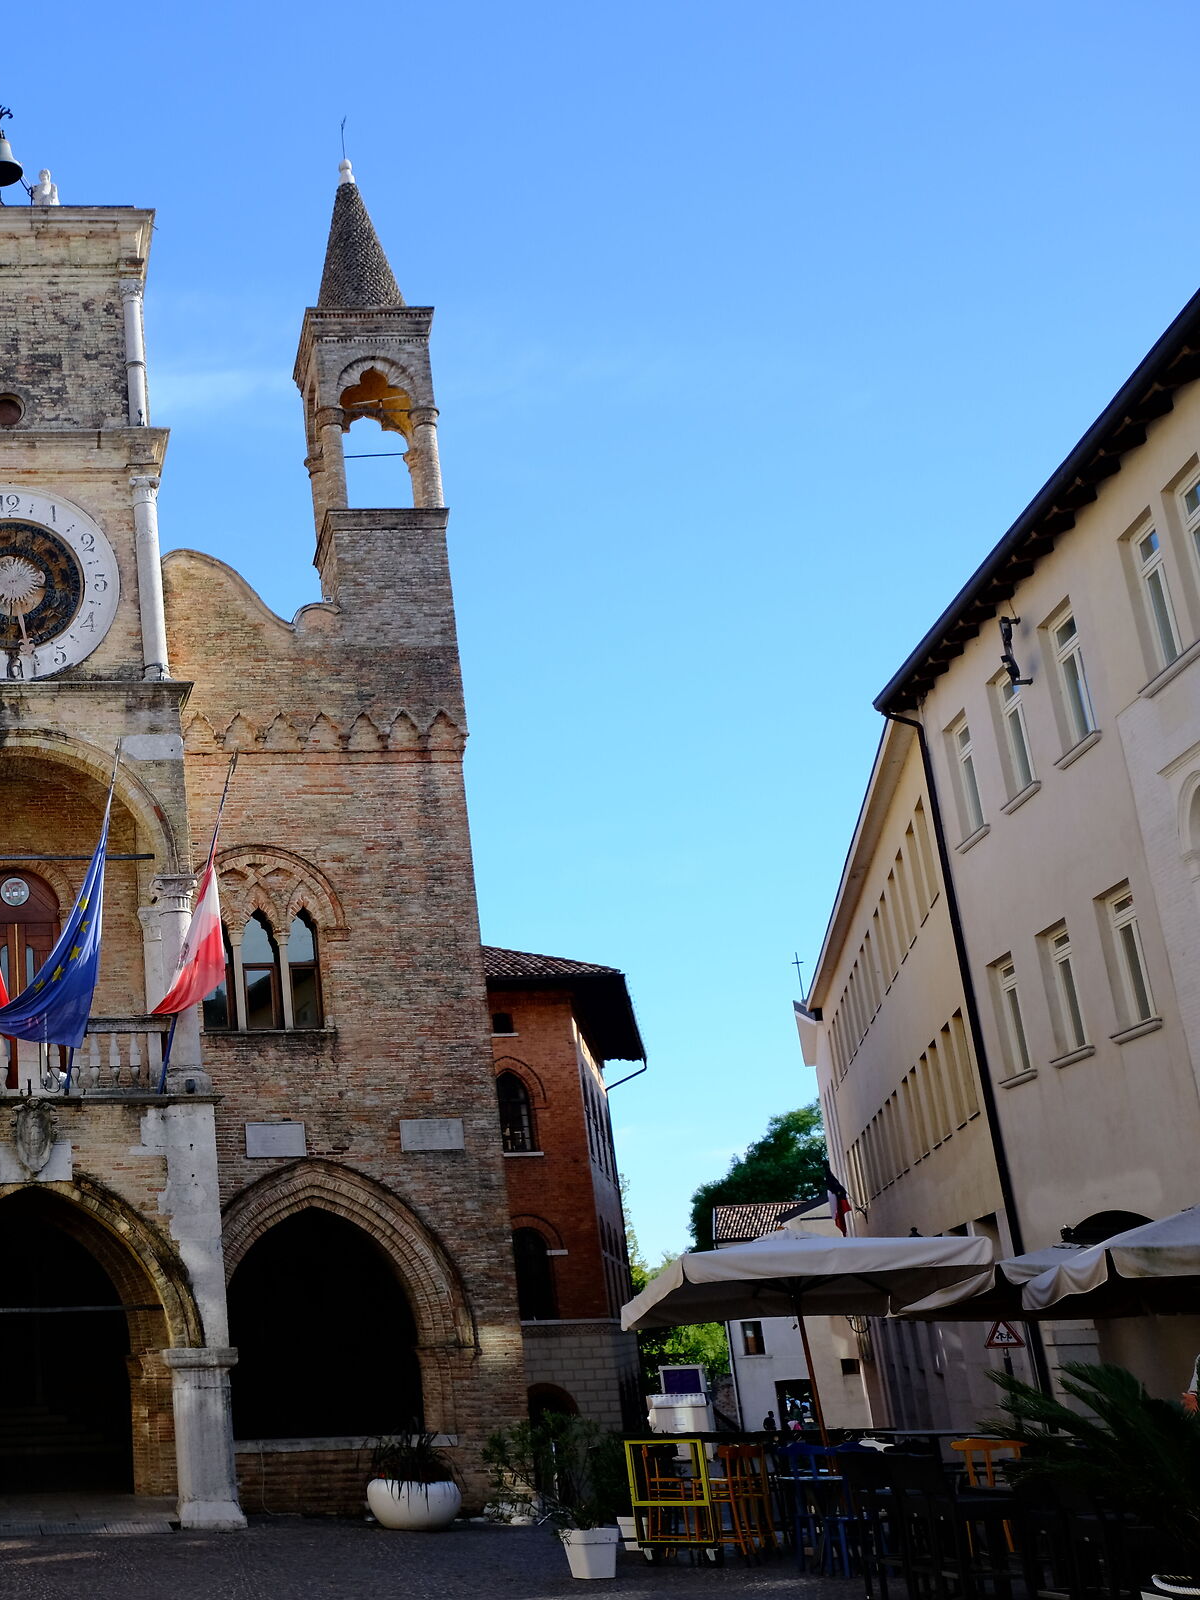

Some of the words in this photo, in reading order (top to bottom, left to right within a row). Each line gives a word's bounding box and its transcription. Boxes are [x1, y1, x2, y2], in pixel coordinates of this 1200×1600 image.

[49, 504, 57, 522] 1
[80, 532, 95, 553] 2
[80, 611, 96, 633] 4
[54, 644, 67, 666] 5
